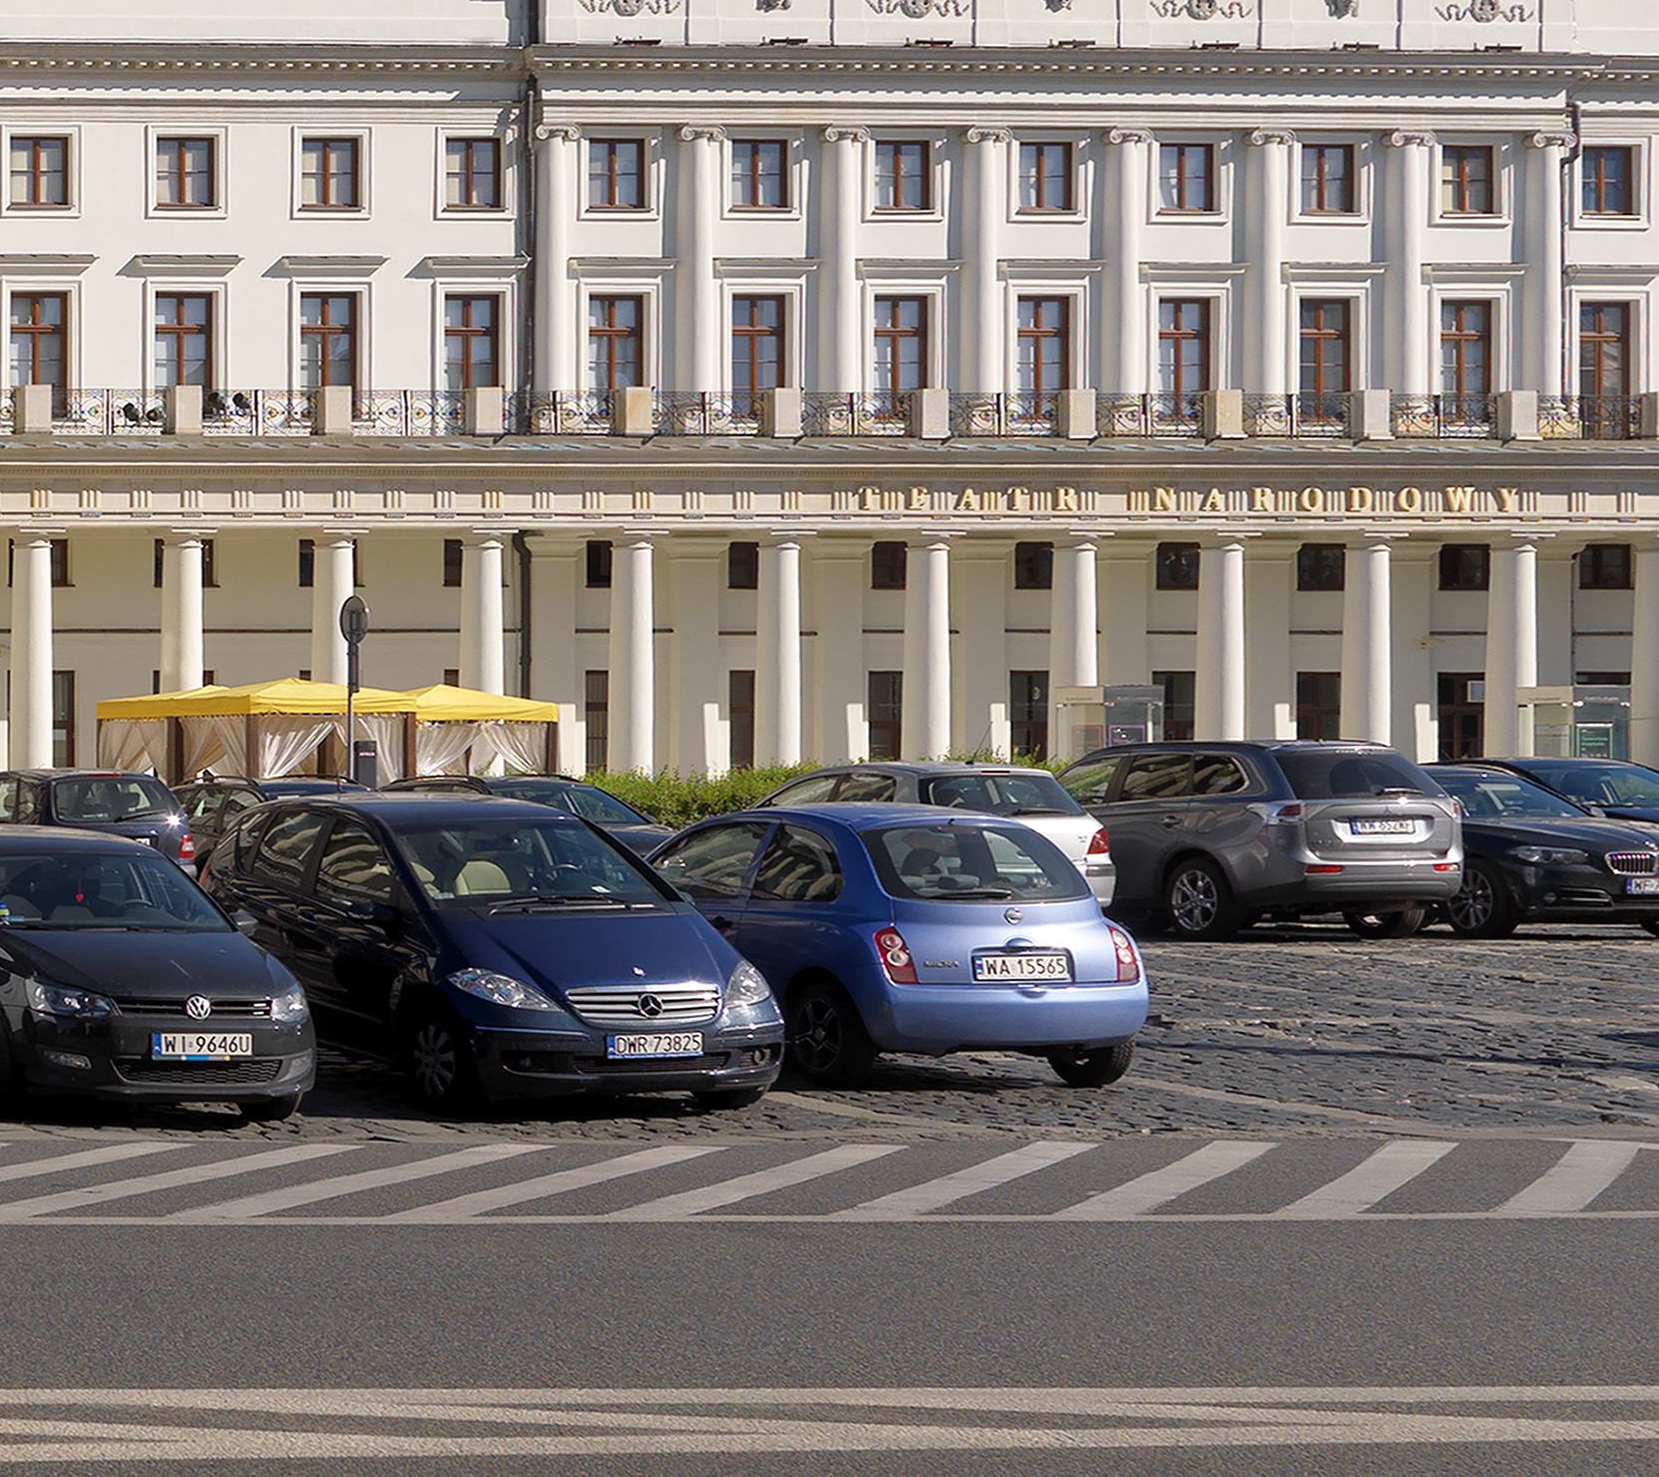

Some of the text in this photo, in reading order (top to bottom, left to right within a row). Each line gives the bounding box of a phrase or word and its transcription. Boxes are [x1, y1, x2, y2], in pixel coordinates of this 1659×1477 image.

[858, 486, 1518, 512] TEATR NARODOWY
[986, 958, 1066, 975] WA 15565
[196, 1035, 249, 1052] 9646U
[616, 1035, 701, 1054] DWR 73825
